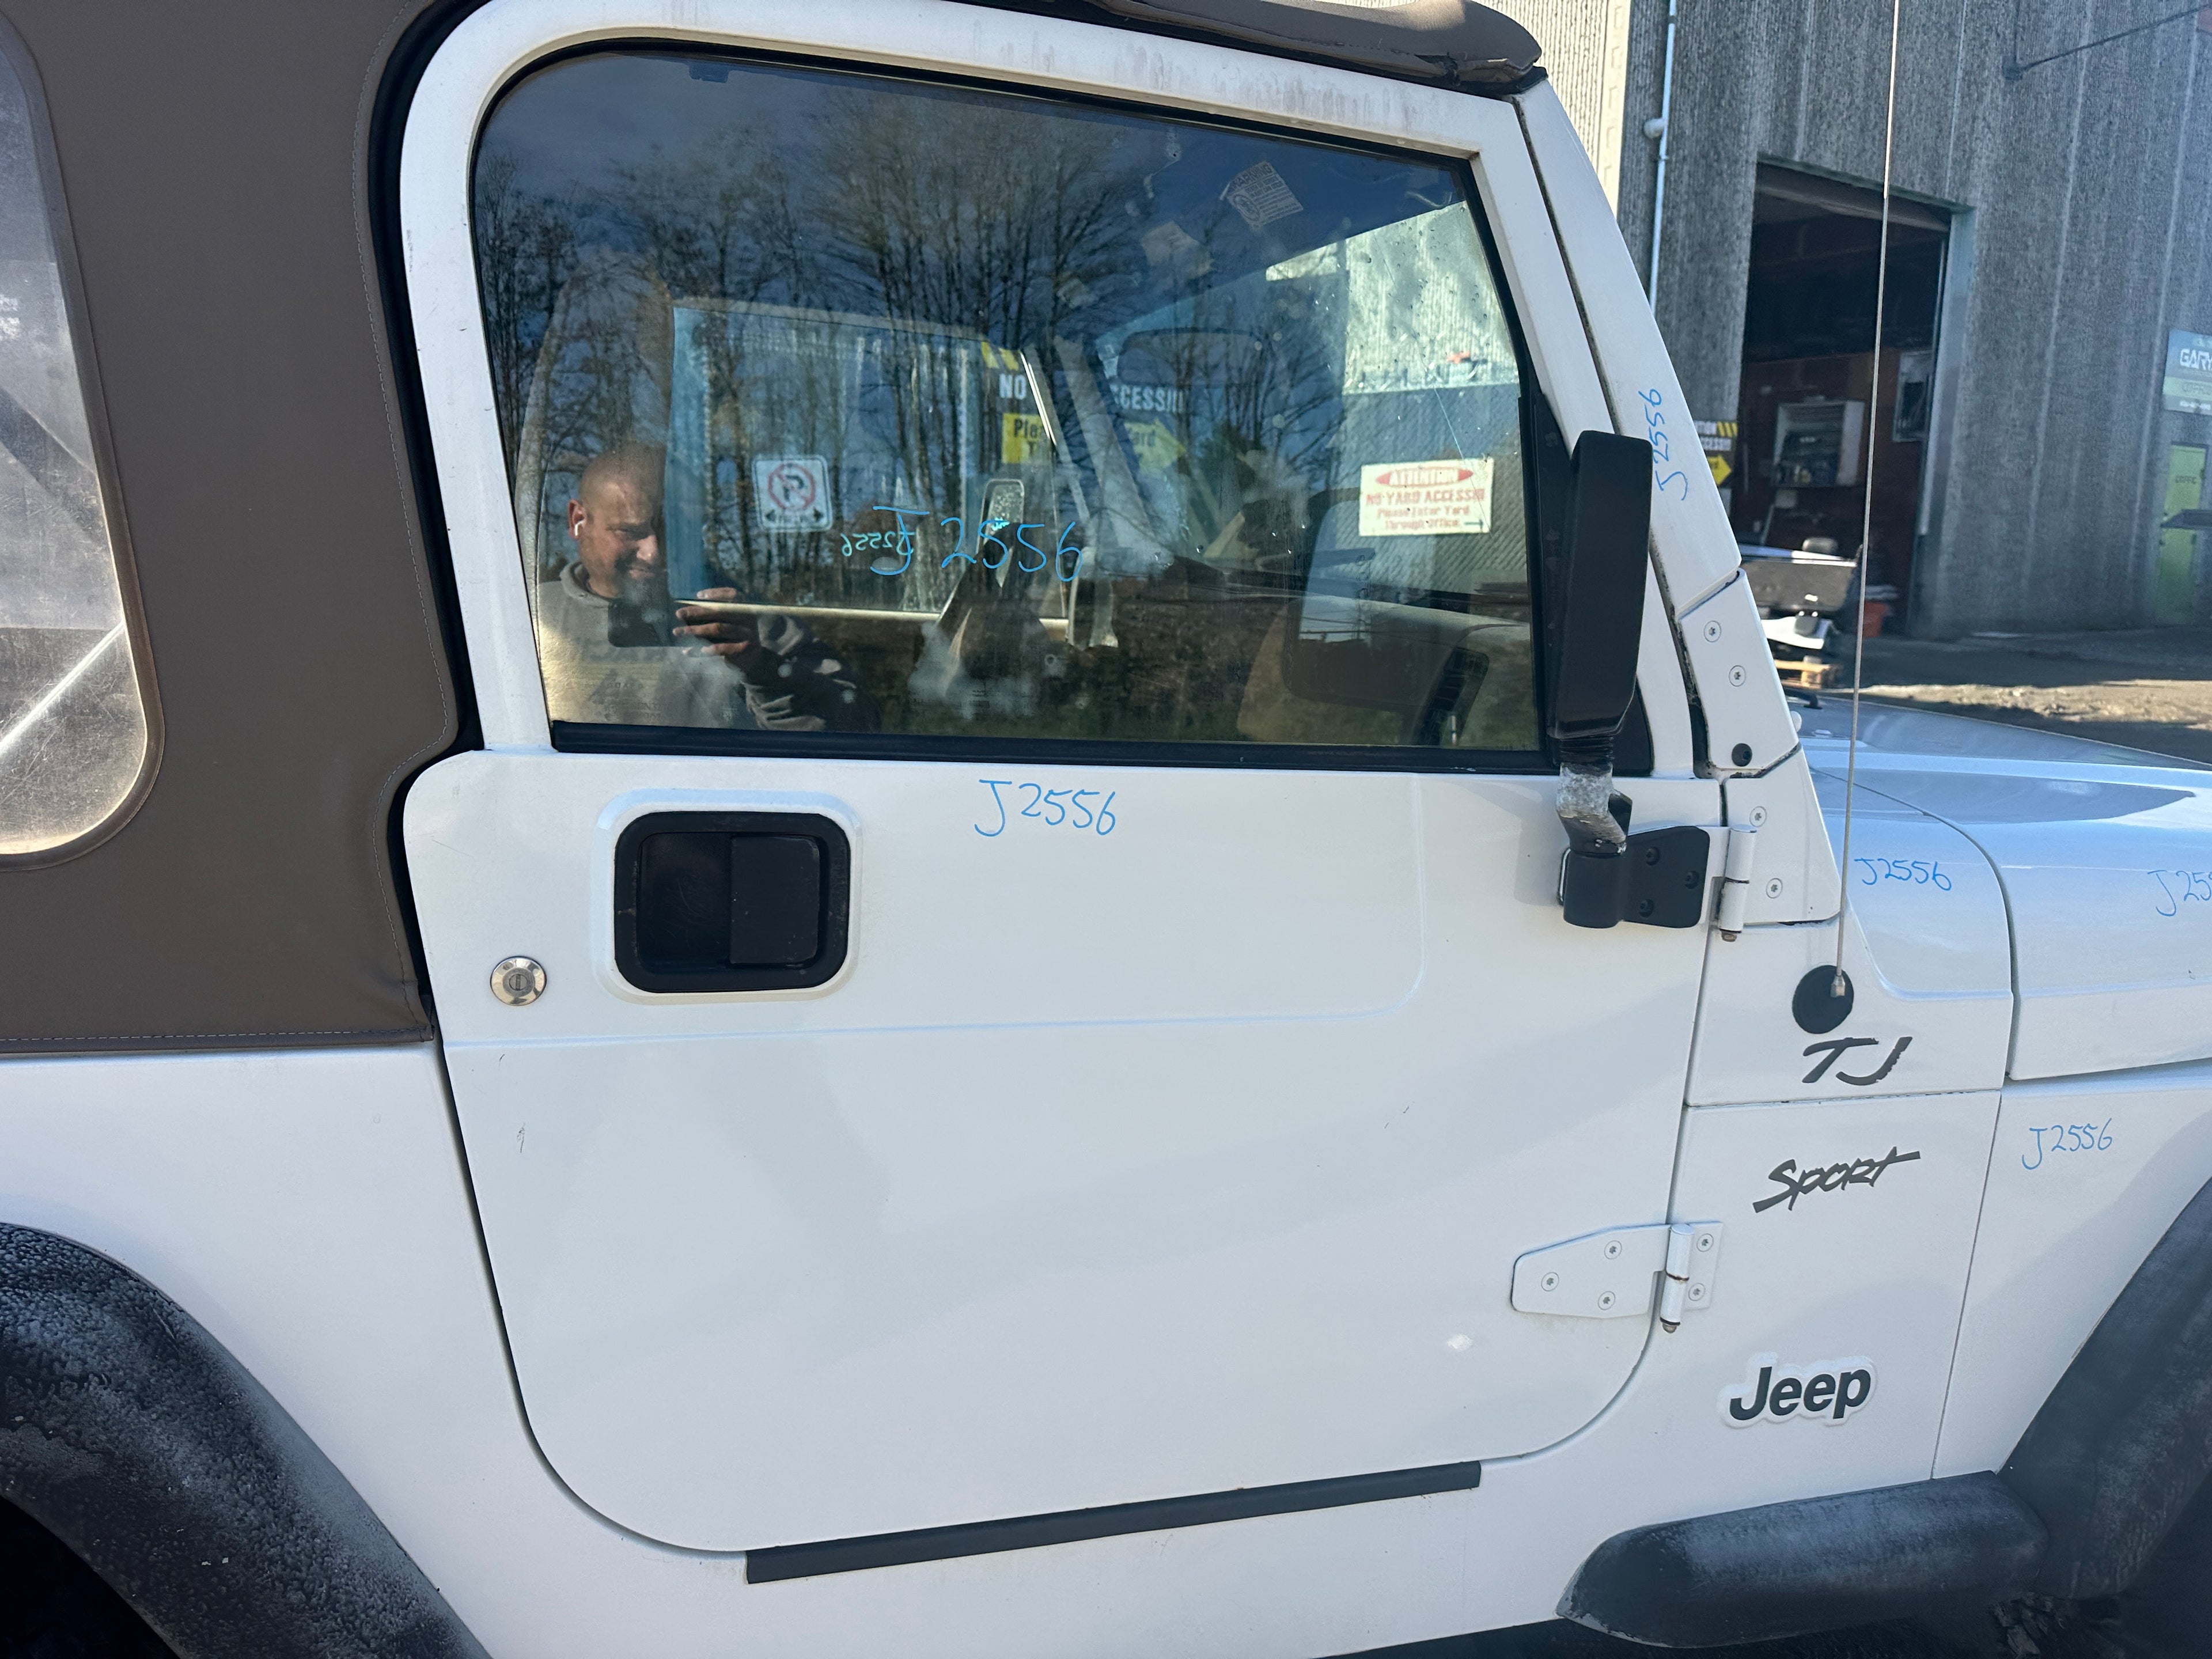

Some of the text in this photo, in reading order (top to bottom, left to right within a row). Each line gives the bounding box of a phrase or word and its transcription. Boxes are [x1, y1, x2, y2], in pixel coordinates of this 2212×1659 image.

[999, 373, 1027, 400] NO
[1638, 389, 1688, 501] J2556
[870, 505, 1083, 582] J2556
[974, 779, 1116, 837] J2556
[1854, 858, 1952, 891] J2556
[2147, 869, 2212, 917] J25
[1802, 1036, 1913, 1086] TJ
[2022, 1118, 2113, 1171] J2556
[1729, 1366, 1872, 1421] Jeep
